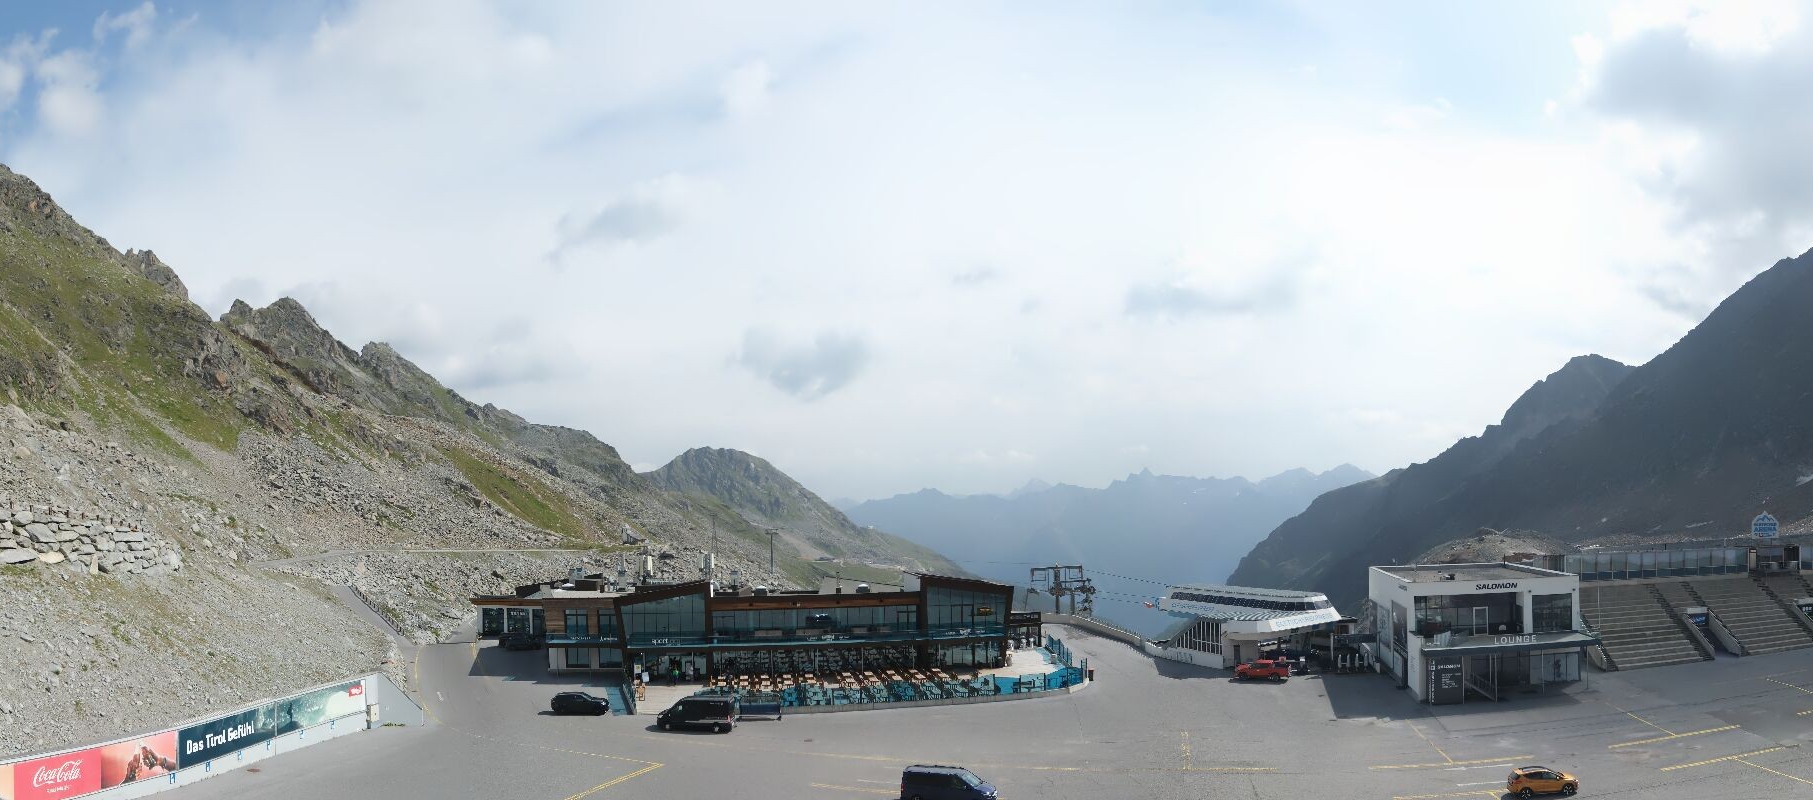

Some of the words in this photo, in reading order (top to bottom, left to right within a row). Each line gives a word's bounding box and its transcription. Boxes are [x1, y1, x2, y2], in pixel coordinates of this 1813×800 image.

[1475, 582, 1518, 591] SALOMON
[1494, 634, 1537, 645] LOUNGE
[186, 739, 204, 755] Das
[205, 729, 226, 748] Tirol
[228, 720, 255, 741] Gefühl
[33, 760, 83, 788] Coca-Cola
